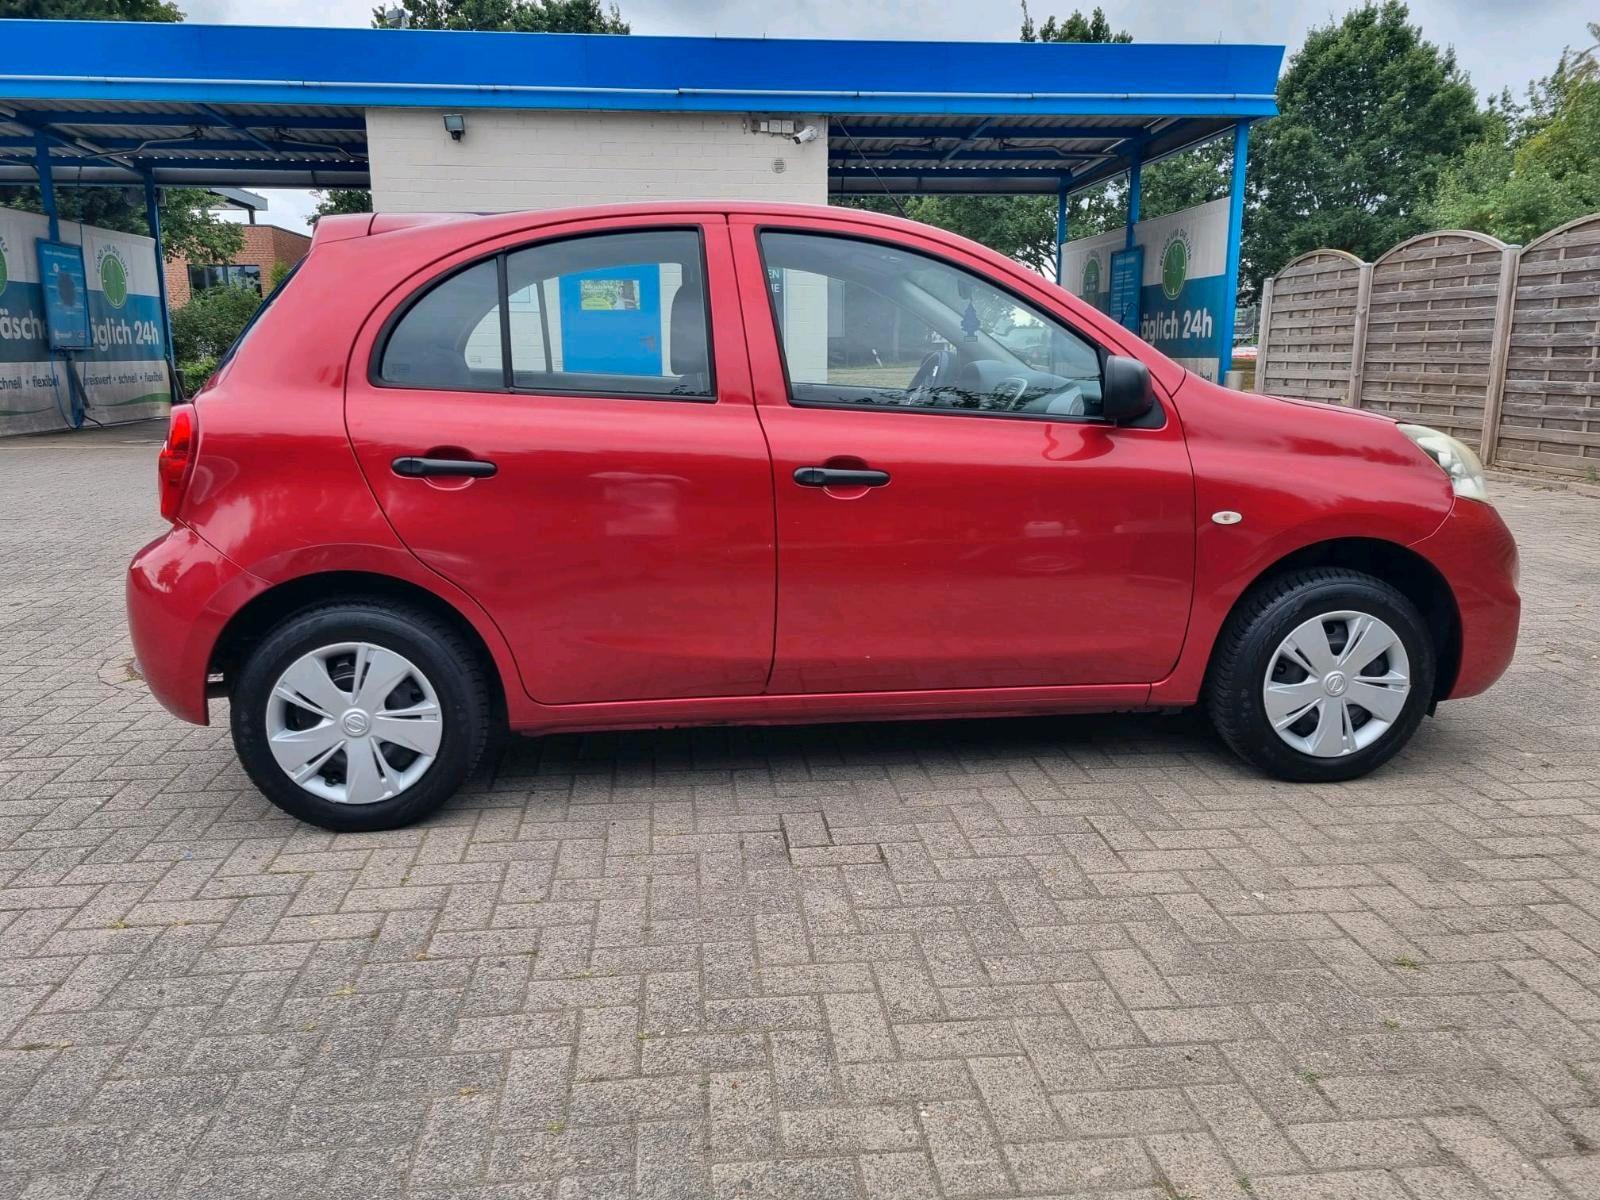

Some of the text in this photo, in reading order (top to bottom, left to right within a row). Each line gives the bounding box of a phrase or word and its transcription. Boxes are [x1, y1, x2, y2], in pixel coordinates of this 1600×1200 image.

[0, 308, 46, 340] äsch
[91, 317, 159, 351] äglich 24h
[1141, 307, 1213, 346] äglich 24h
[0, 376, 23, 390] chnell
